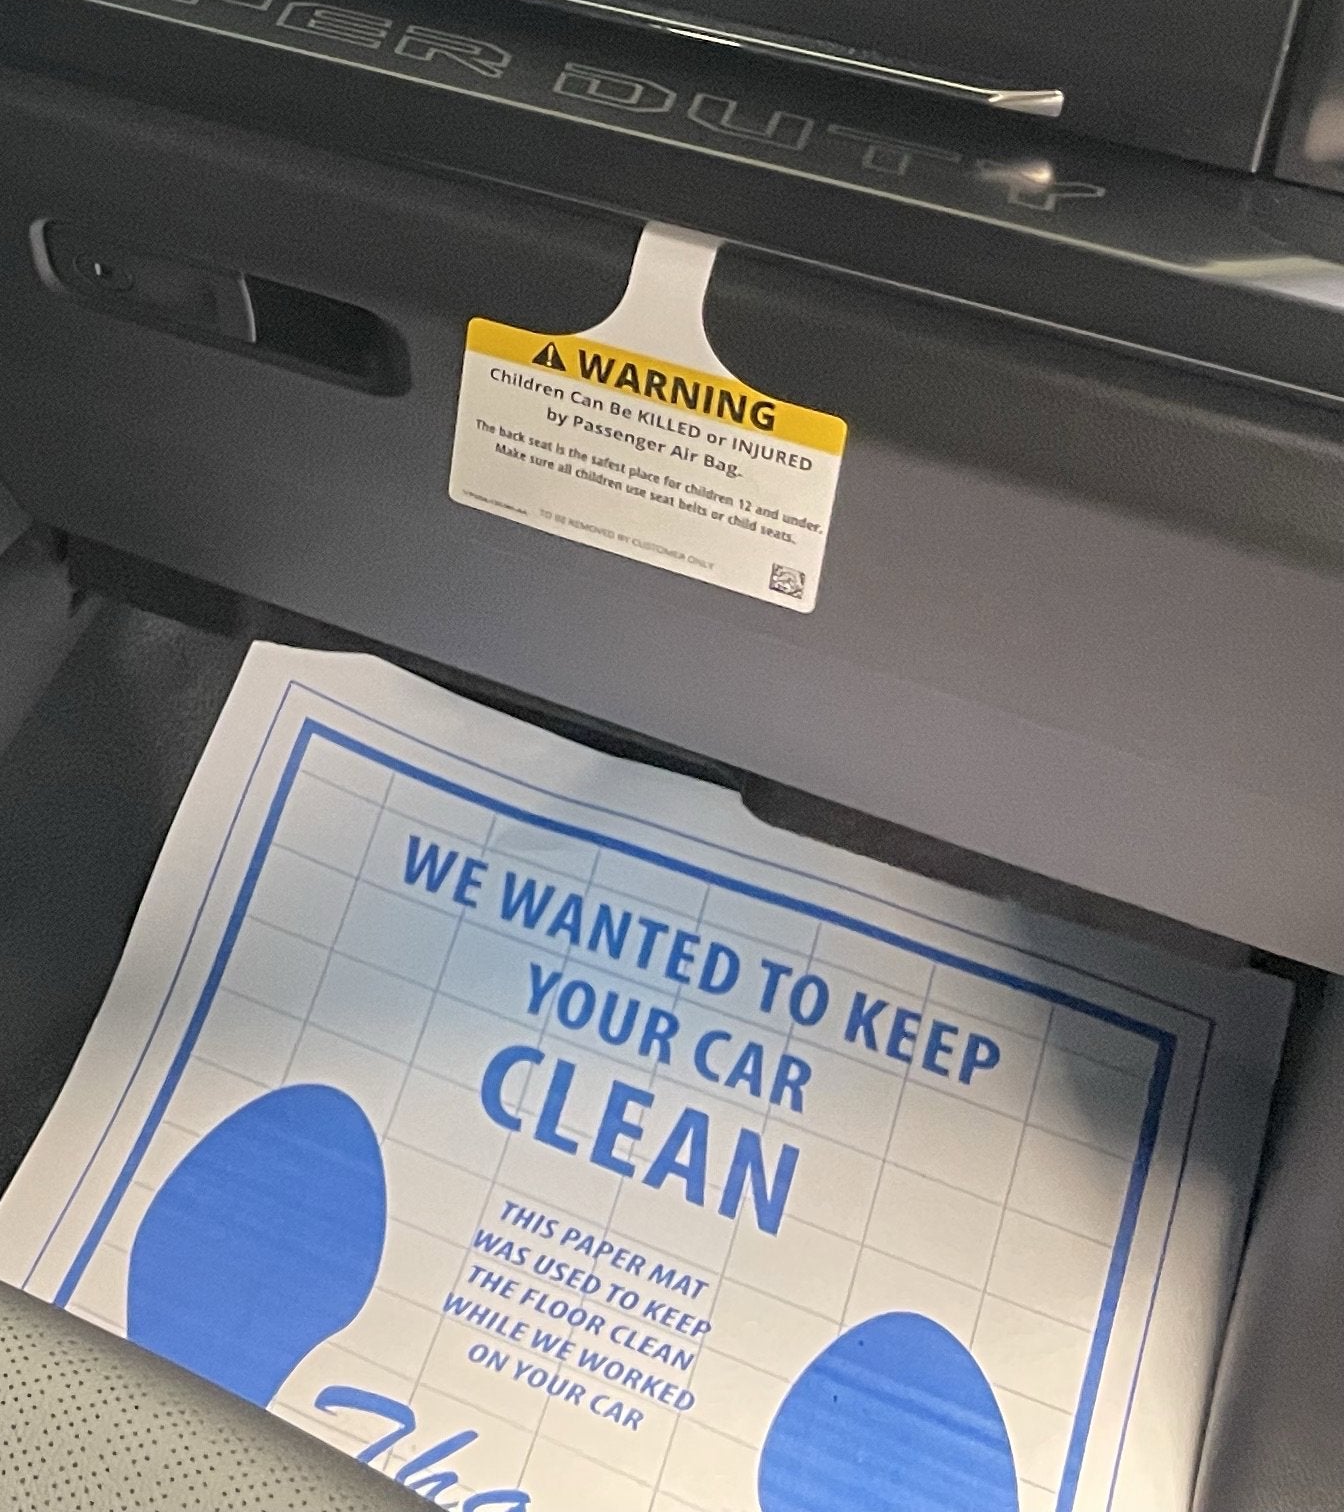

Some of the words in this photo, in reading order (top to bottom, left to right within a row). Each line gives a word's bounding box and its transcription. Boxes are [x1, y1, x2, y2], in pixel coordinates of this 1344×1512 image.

[552, 61, 1107, 212] DUTY
[490, 367, 565, 400] Children
[570, 391, 604, 411] Can
[610, 401, 632, 419] Be
[637, 410, 701, 439] KILLED
[706, 433, 728, 446] or
[732, 437, 813, 471] INJURED
[546, 406, 569, 427] by
[573, 415, 667, 453] Passenger
[670, 445, 699, 463] Air
[703, 453, 744, 479] Bag.
[578, 349, 776, 432] WARNING
[476, 418, 496, 433] The
[499, 426, 525, 443] back
[528, 437, 553, 452] seat
[555, 443, 565, 456] is
[568, 448, 588, 462] the
[591, 454, 626, 474] safest
[628, 466, 661, 485] place
[664, 475, 682, 491] for
[685, 483, 734, 507] children
[738, 498, 752, 512] 12
[755, 505, 780, 520] and
[782, 512, 824, 535] under.
[495, 442, 527, 462] Make
[530, 454, 554, 469] sure
[557, 462, 572, 475] all
[575, 468, 623, 491] children
[625, 484, 647, 498] use
[649, 491, 674, 507] seat
[678, 497, 708, 517] belts
[711, 510, 725, 522] or
[727, 515, 758, 532] child
[760, 524, 798, 545] seats.
[539, 508, 553, 520] TO
[554, 513, 567, 525] BE
[568, 517, 615, 540] REMOVED
[631, 537, 686, 562] CUSTOMER
[403, 836, 489, 911] WE
[498, 870, 741, 996] WANTED
[759, 958, 828, 1025] TO
[845, 993, 1000, 1082] KEEP
[526, 960, 682, 1065] YOUR
[693, 1029, 812, 1113] CAR
[479, 1043, 799, 1234] CLEAN
[473, 1229, 531, 1266] WAS
[533, 1254, 602, 1295] USED
[605, 1283, 640, 1311] TO
[643, 1300, 712, 1338] KEEP
[499, 1200, 560, 1239] THIS
[560, 1227, 647, 1276] PAPER
[647, 1264, 710, 1300] MAT
[442, 1292, 530, 1342] WHILE
[530, 1328, 576, 1362] WE
[577, 1348, 696, 1412] WORKED
[467, 1265, 520, 1300] THE
[519, 1288, 606, 1336] FLOOR
[609, 1325, 695, 1371] CLEAN
[467, 1343, 510, 1373] ON
[513, 1359, 586, 1407] YOUR
[589, 1394, 644, 1432] CAR
